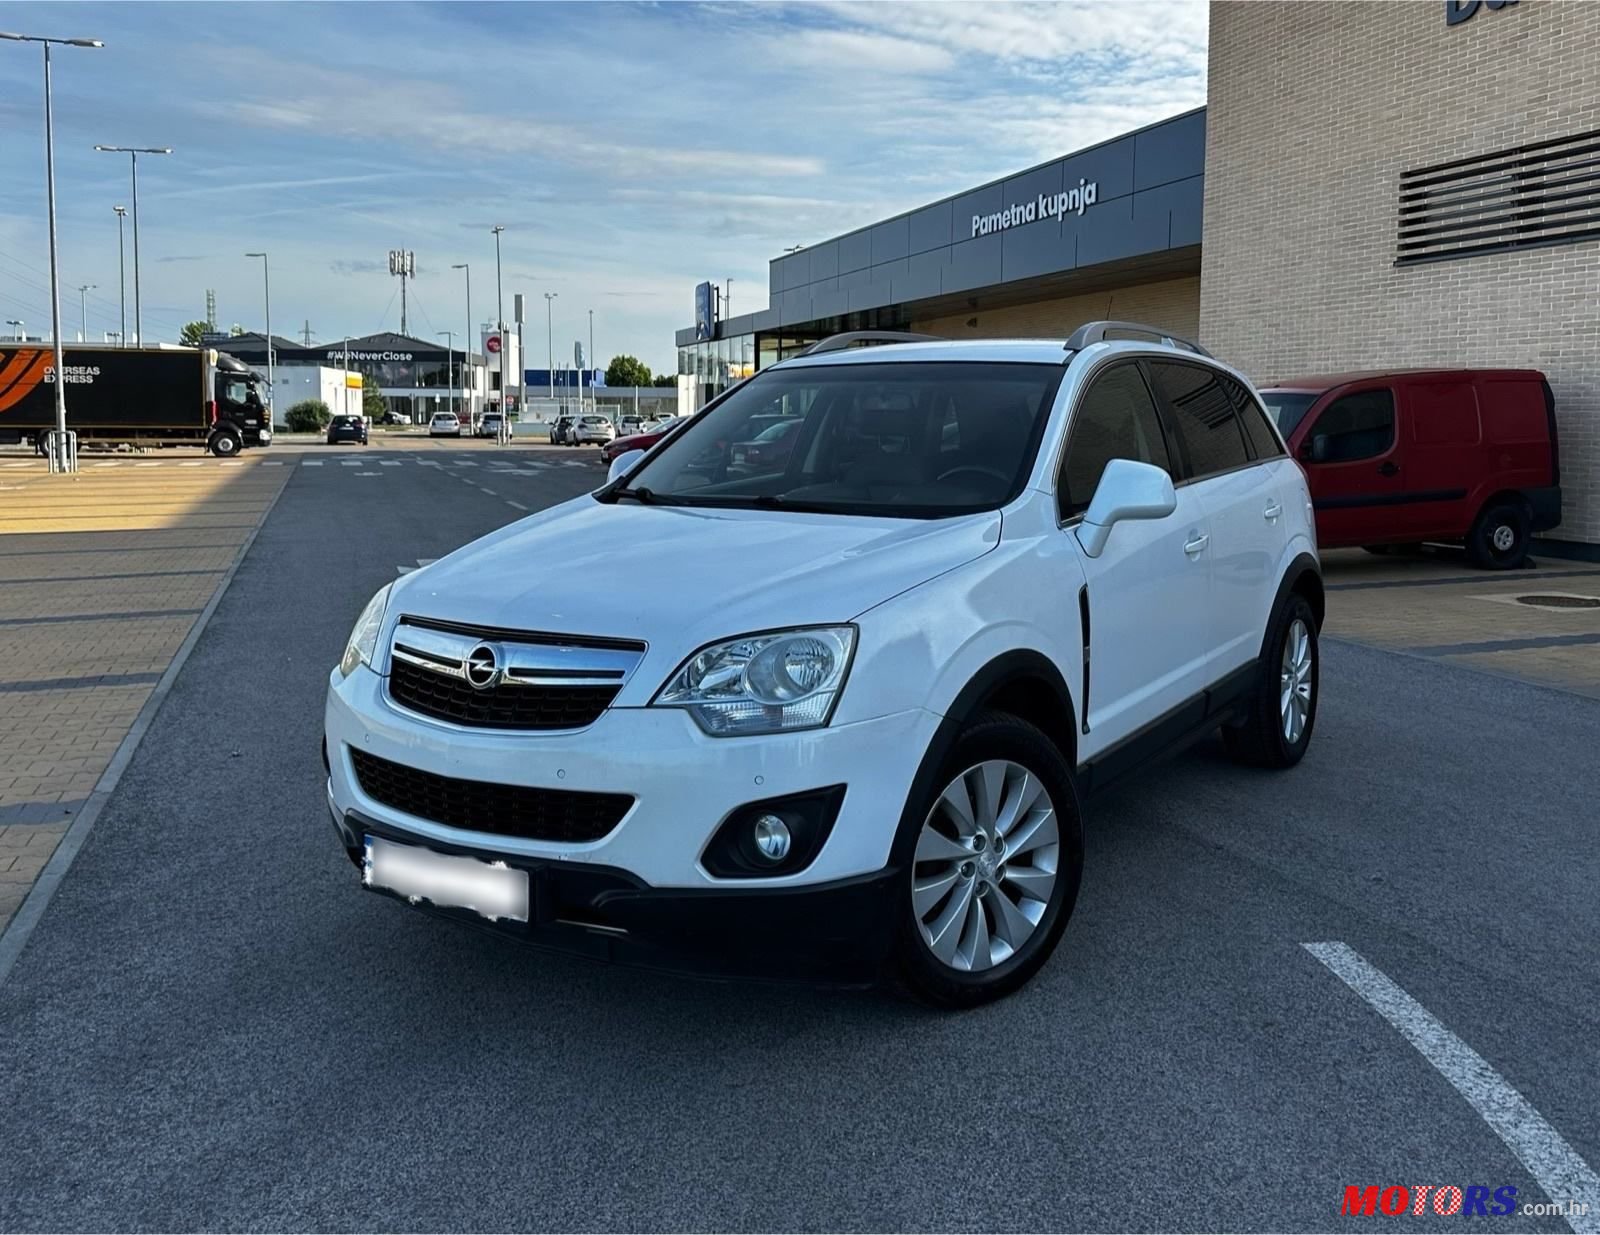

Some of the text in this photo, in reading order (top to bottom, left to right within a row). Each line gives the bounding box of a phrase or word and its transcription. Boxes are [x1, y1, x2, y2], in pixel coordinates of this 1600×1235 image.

[971, 178, 1098, 238] Pametna kupnja
[326, 351, 413, 361] #WeNeverClose
